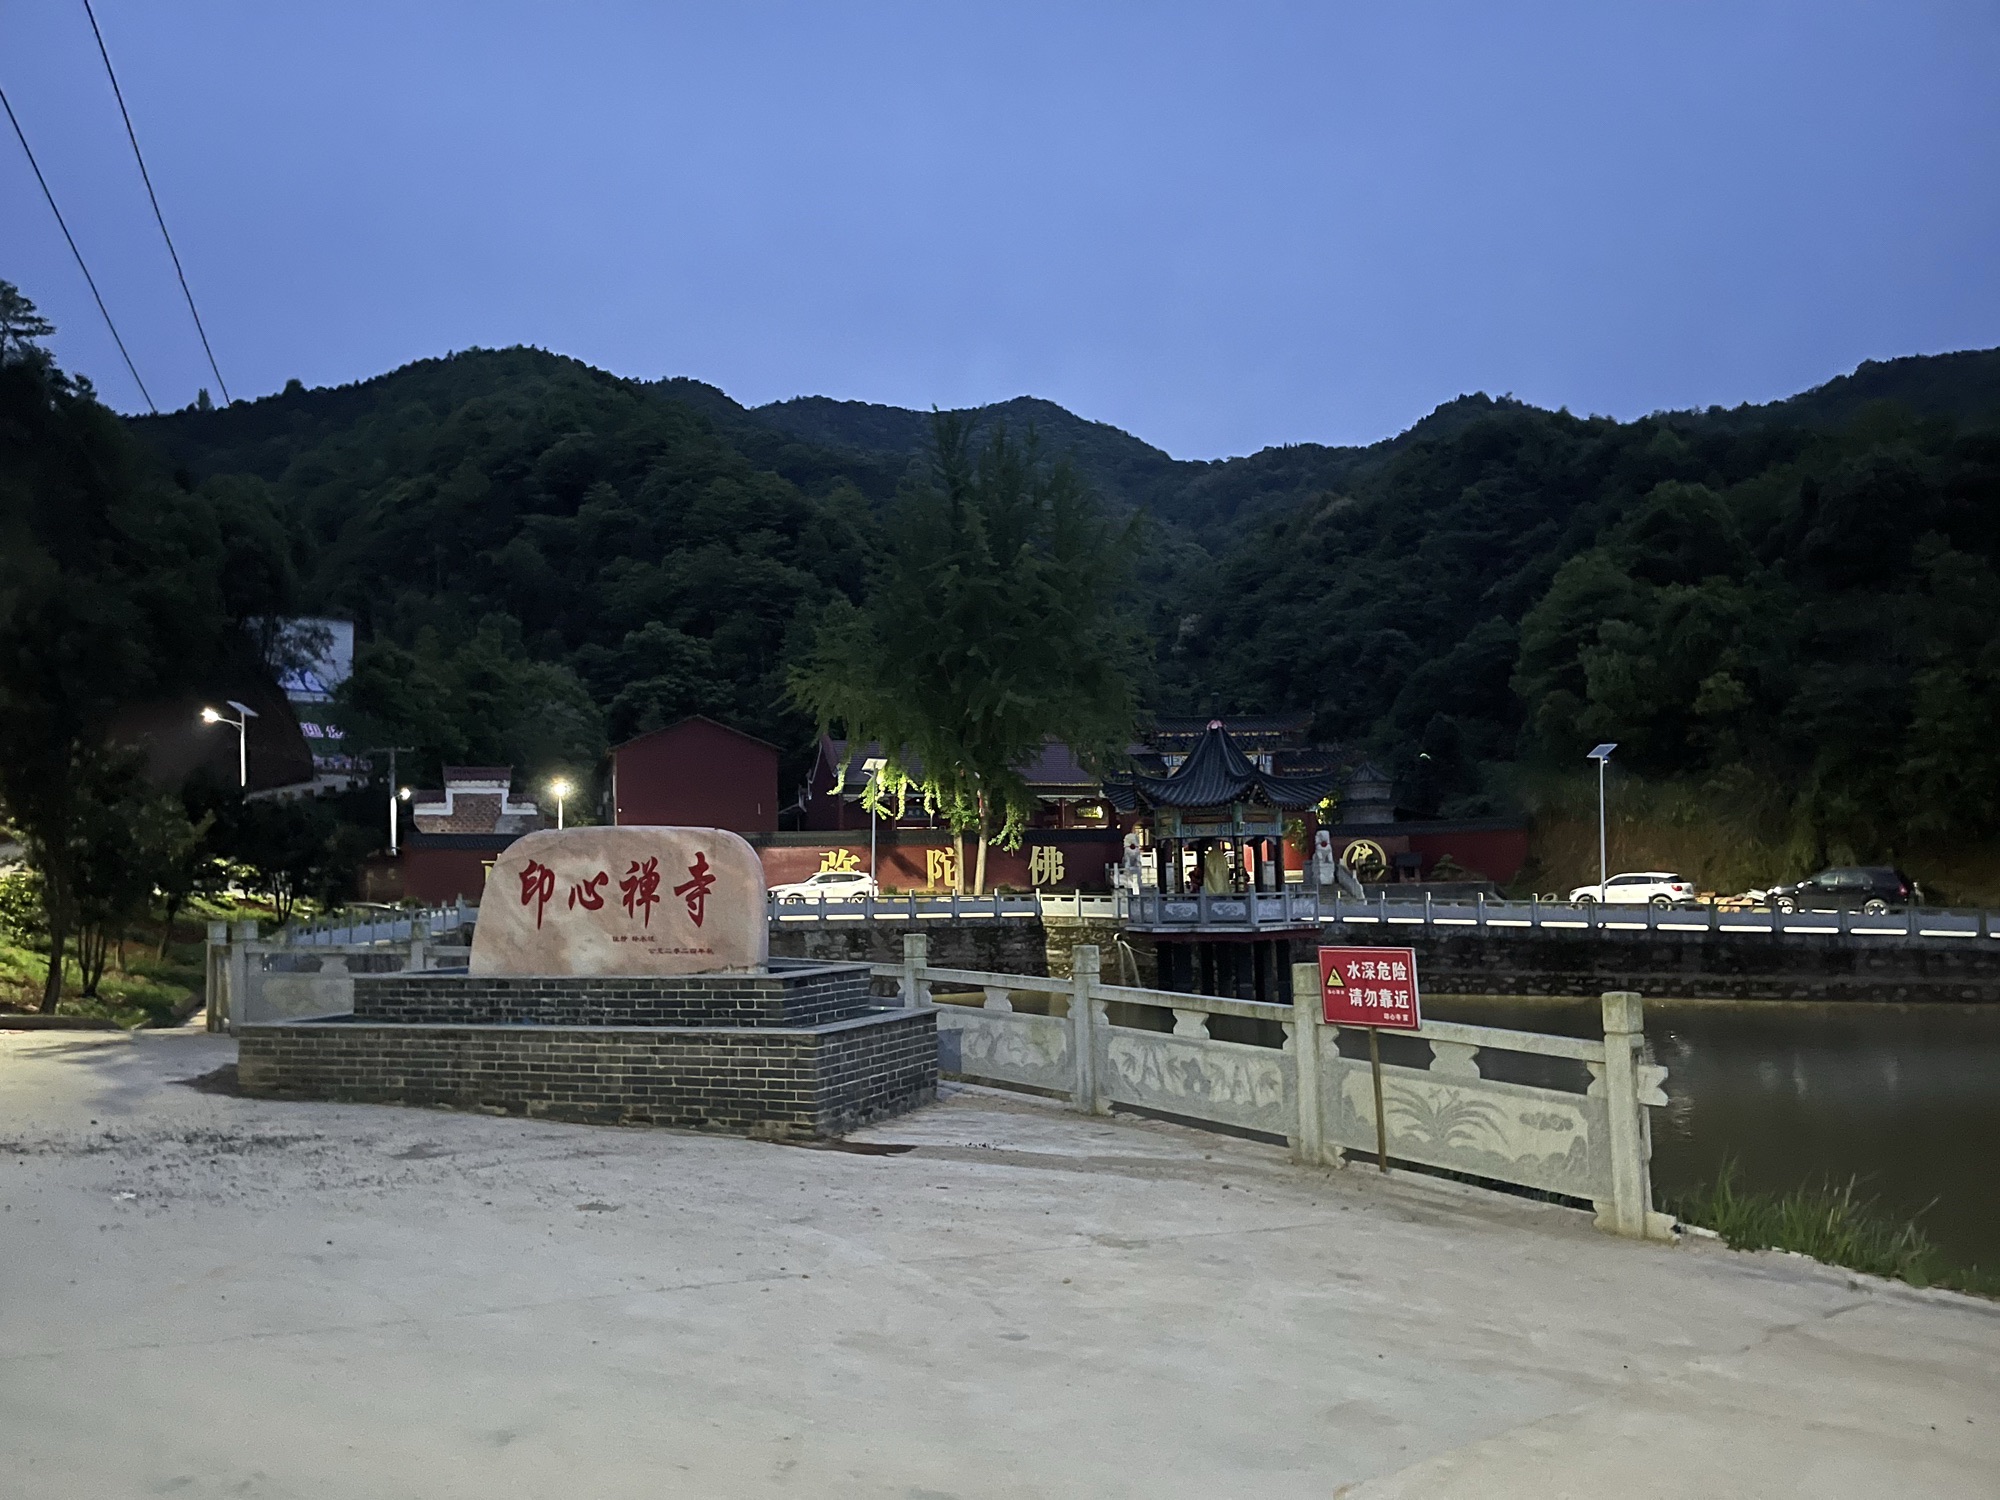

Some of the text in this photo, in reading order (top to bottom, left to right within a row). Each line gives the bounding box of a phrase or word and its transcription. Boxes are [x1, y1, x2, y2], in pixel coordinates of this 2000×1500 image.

[518, 851, 717, 931] 印心禅寺
[1346, 961, 1408, 981] 水深危险
[1348, 988, 1410, 1009] 请勿靠近
